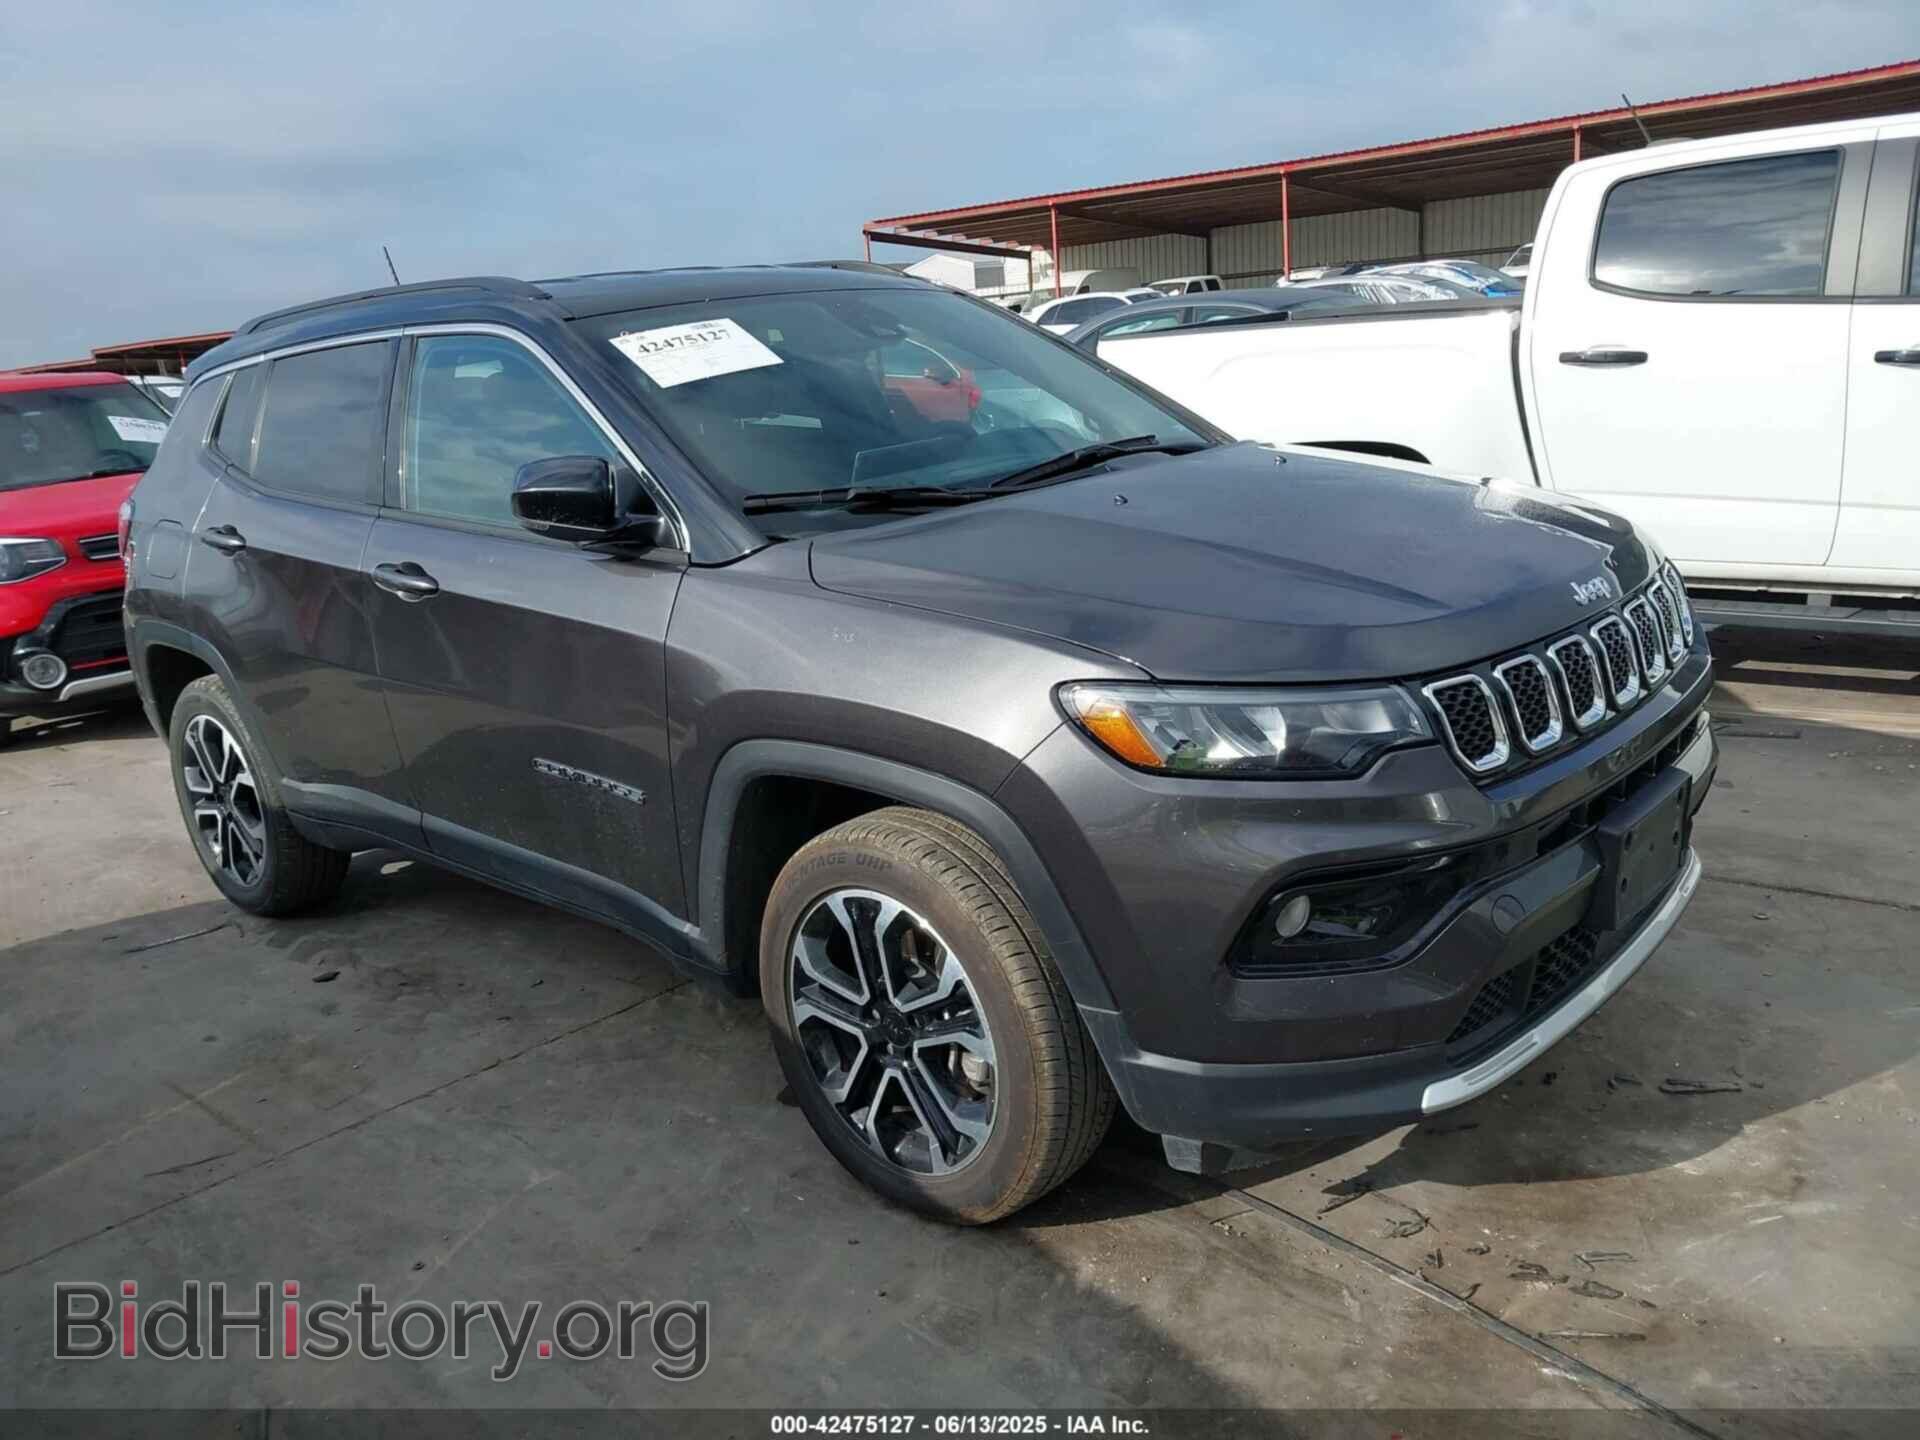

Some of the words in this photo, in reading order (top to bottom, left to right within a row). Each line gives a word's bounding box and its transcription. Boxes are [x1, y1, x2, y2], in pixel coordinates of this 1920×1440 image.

[637, 328, 731, 353] 42475127
[1569, 576, 1612, 605] Jeep
[855, 852, 894, 872] UHP
